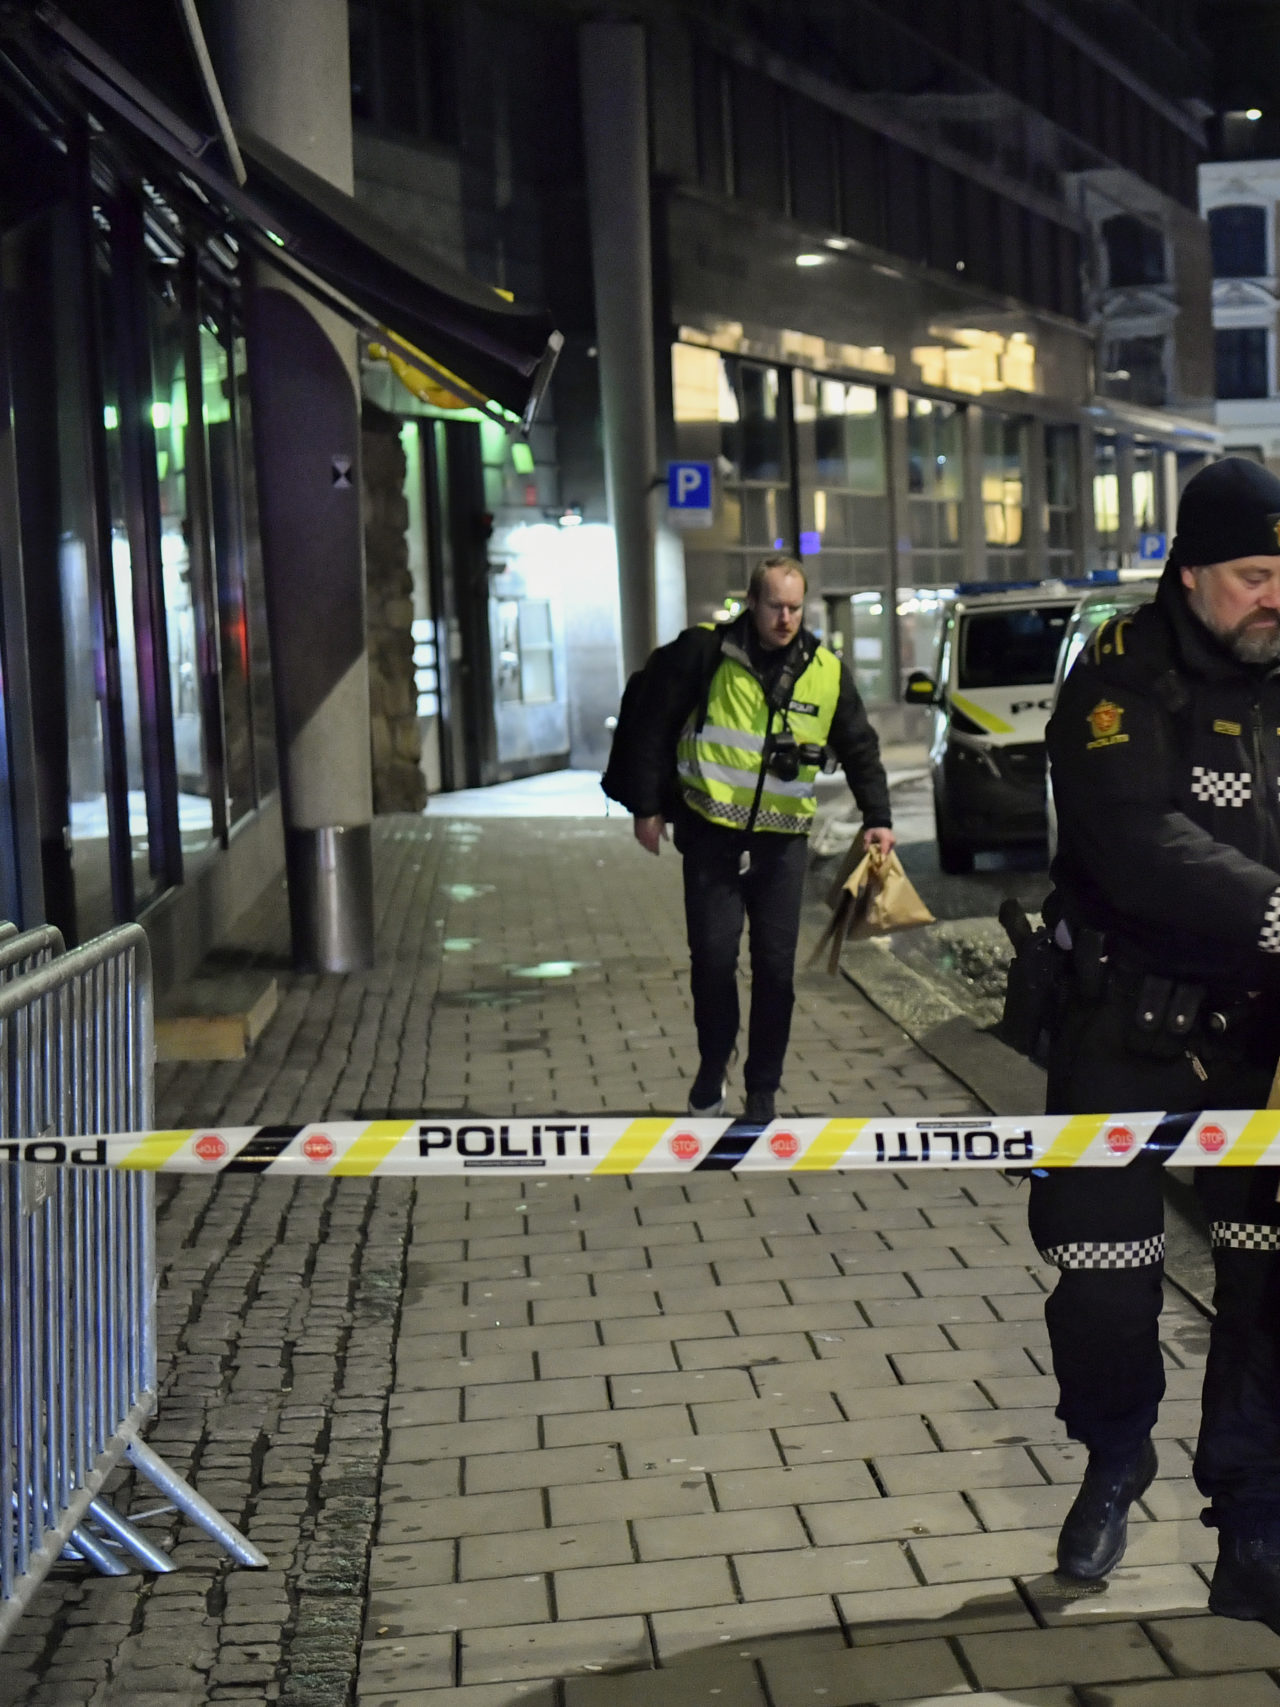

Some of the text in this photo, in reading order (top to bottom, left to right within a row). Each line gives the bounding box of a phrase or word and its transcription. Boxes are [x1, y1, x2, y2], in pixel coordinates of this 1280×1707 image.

[677, 467, 702, 503] P
[419, 1125, 590, 1157] POLITI
[1108, 1133, 1134, 1145] STOP
[1199, 1132, 1225, 1144] STOP
[671, 1139, 699, 1151] STOP
[771, 1139, 798, 1150] STOP
[874, 1130, 1033, 1161] POLITI
